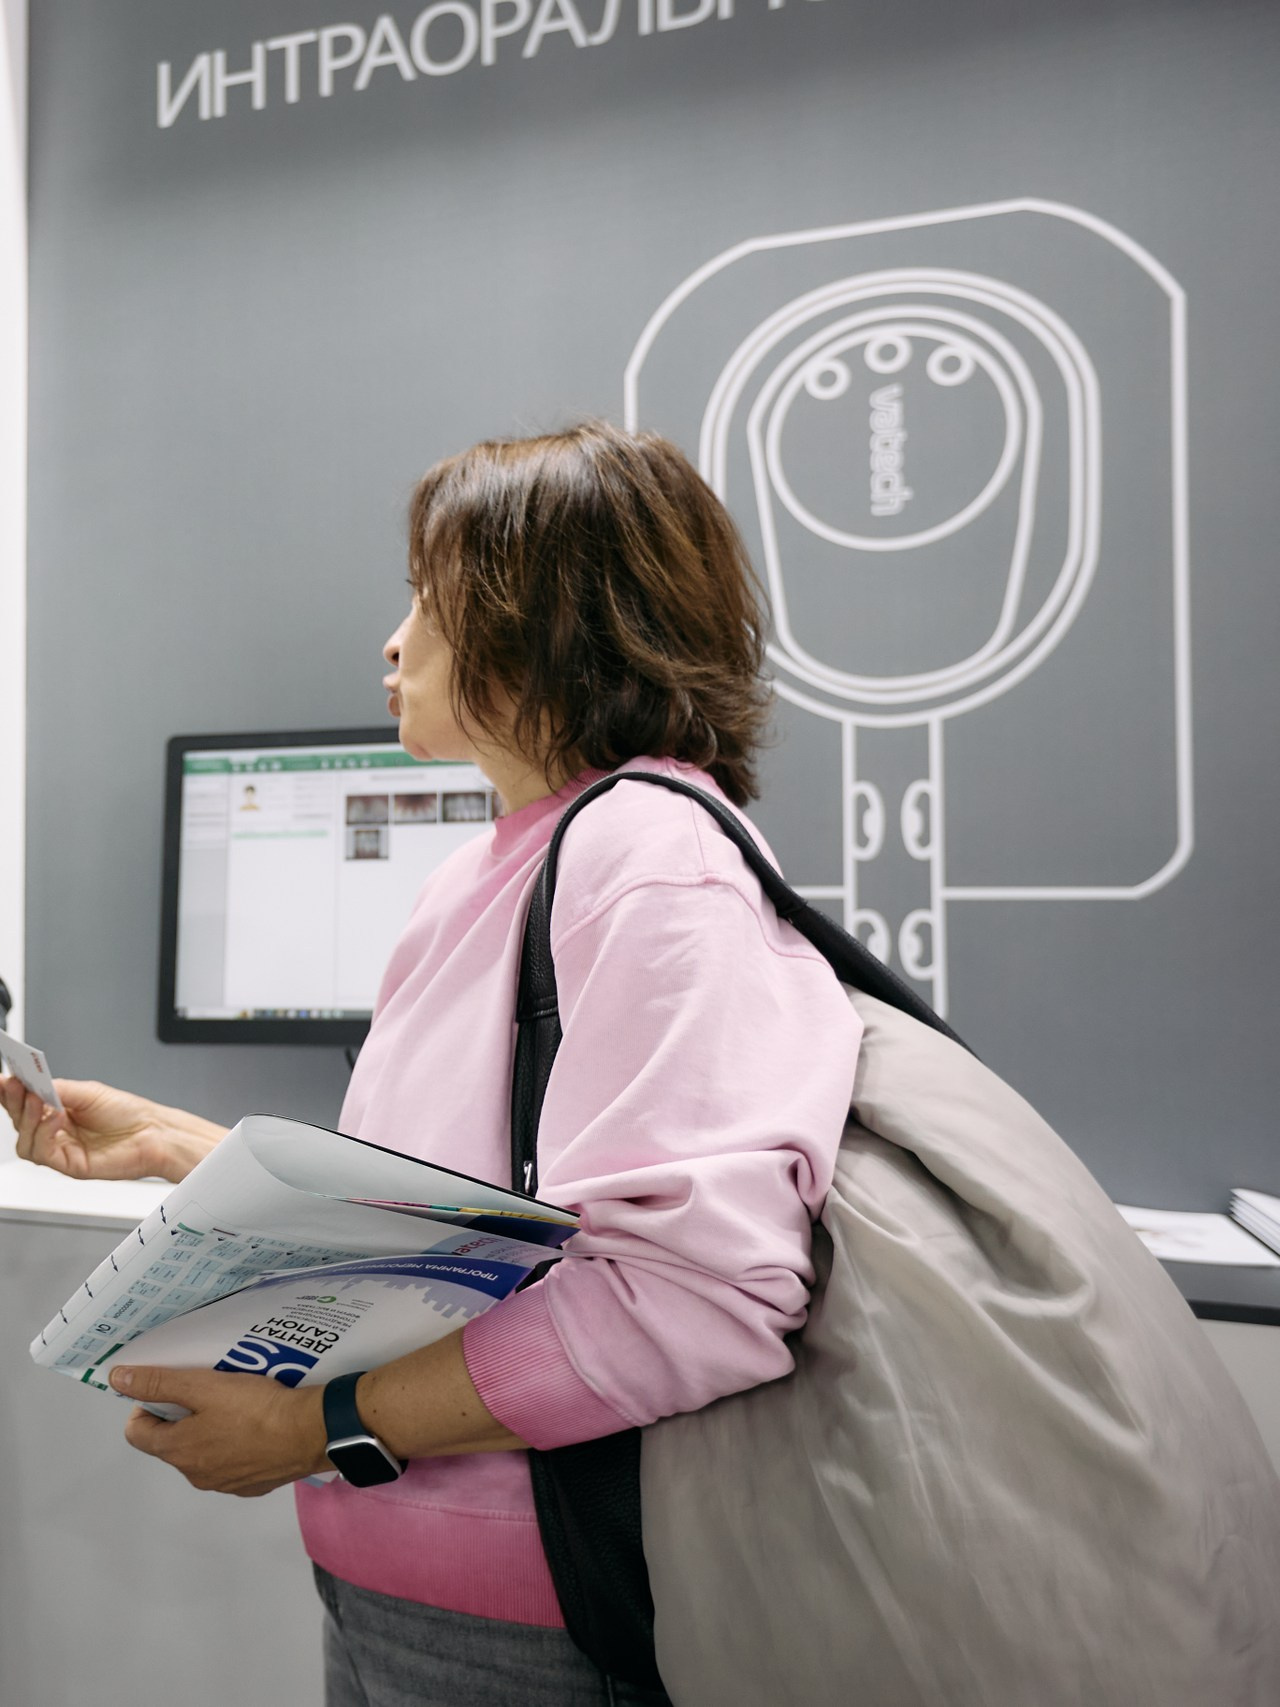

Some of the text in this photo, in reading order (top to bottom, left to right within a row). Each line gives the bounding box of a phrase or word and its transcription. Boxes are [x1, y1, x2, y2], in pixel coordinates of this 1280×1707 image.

[156, 0, 822, 128] ИНТРАОРАЛЬ
[869, 383, 914, 516] vatech
[425, 1263, 499, 1281] ПРОГРАММА
[250, 1324, 333, 1354] ДЕНТАЛ
[266, 1317, 340, 1343] САЛОН
